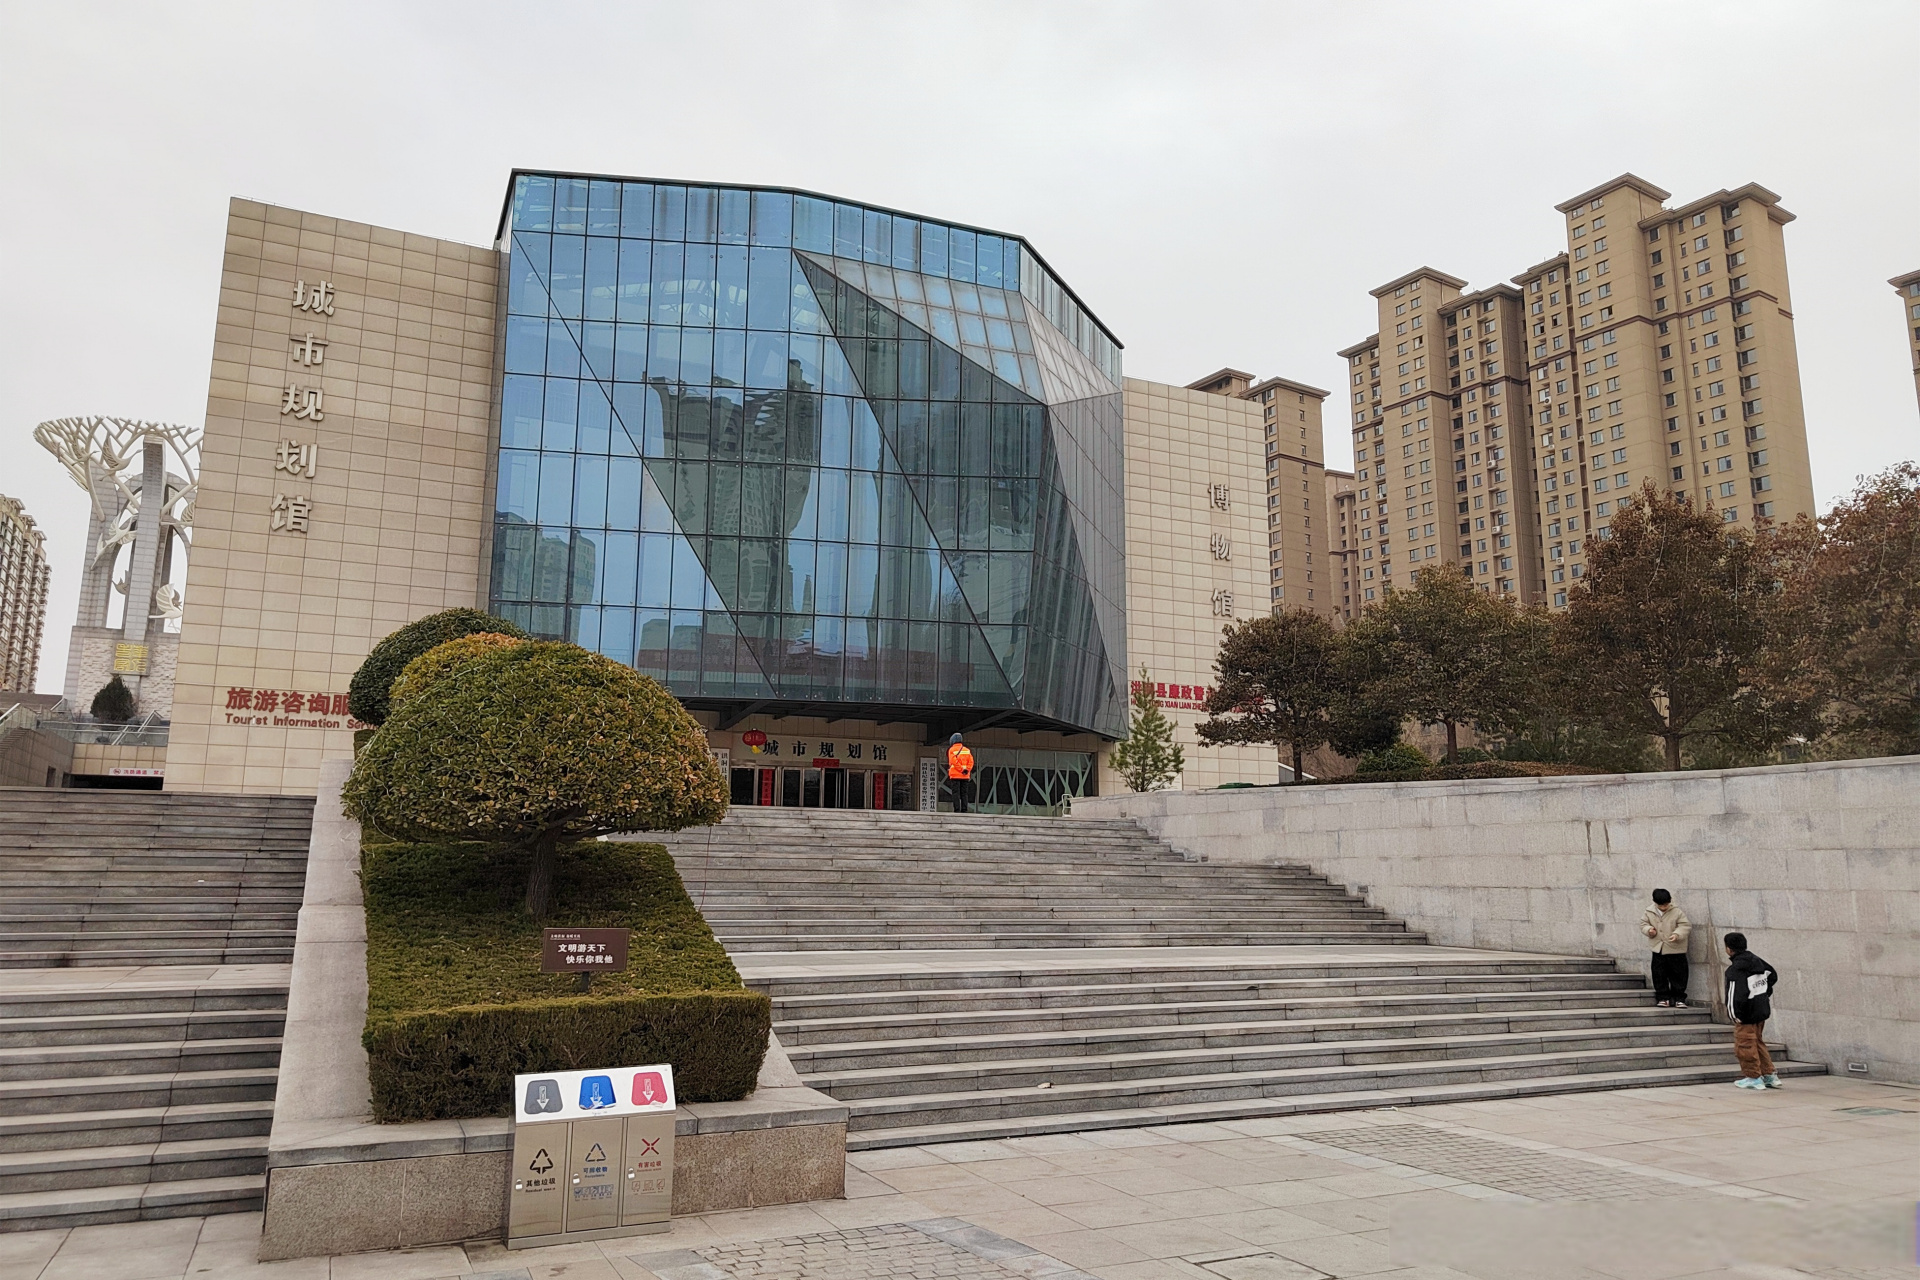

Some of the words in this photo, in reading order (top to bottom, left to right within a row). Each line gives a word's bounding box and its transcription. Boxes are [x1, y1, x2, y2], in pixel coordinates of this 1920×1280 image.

[269, 279, 336, 533] 城市规划馆
[1207, 482, 1234, 617] 博物馆
[273, 715, 340, 729] Information
[762, 740, 888, 761] 城市规划馆
[558, 943, 606, 953] 文明游天下
[566, 954, 613, 964] 快乐你我他
[526, 1178, 556, 1188] 其他垃圾
